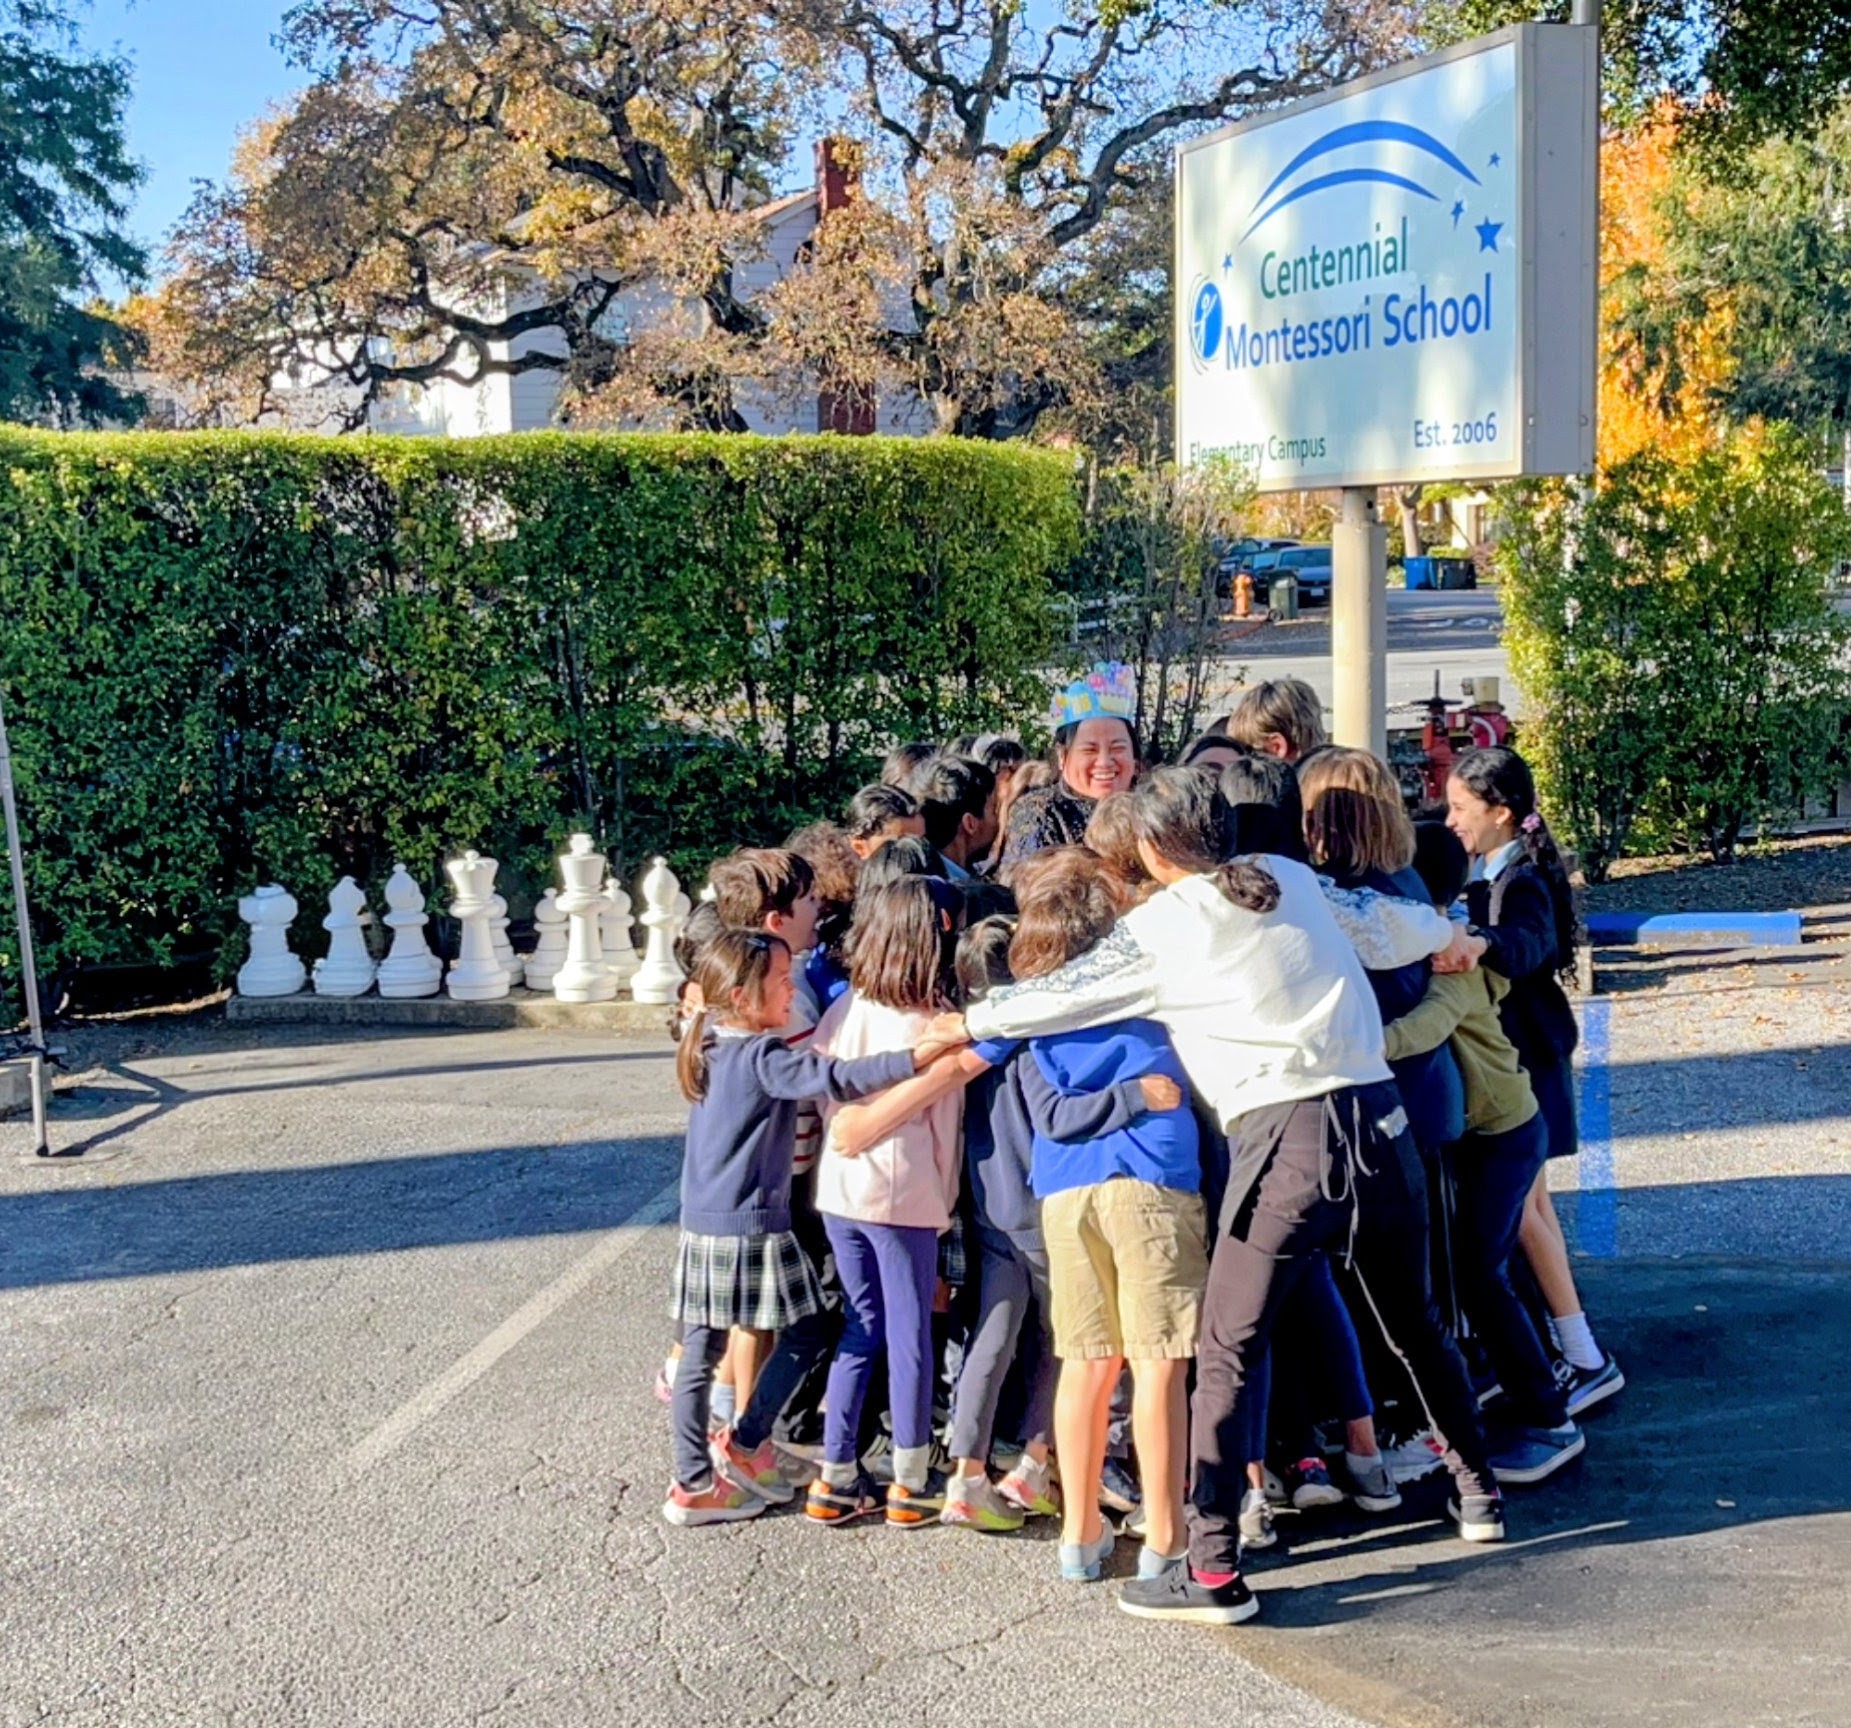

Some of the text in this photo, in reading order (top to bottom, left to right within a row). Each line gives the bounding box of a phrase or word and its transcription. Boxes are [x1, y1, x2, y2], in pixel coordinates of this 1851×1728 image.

[1260, 216, 1408, 299] Centennial
[1226, 272, 1492, 370] Montessori School
[1189, 435, 1326, 470] Elemntary Campus
[1414, 411, 1497, 448] Est. 2006
